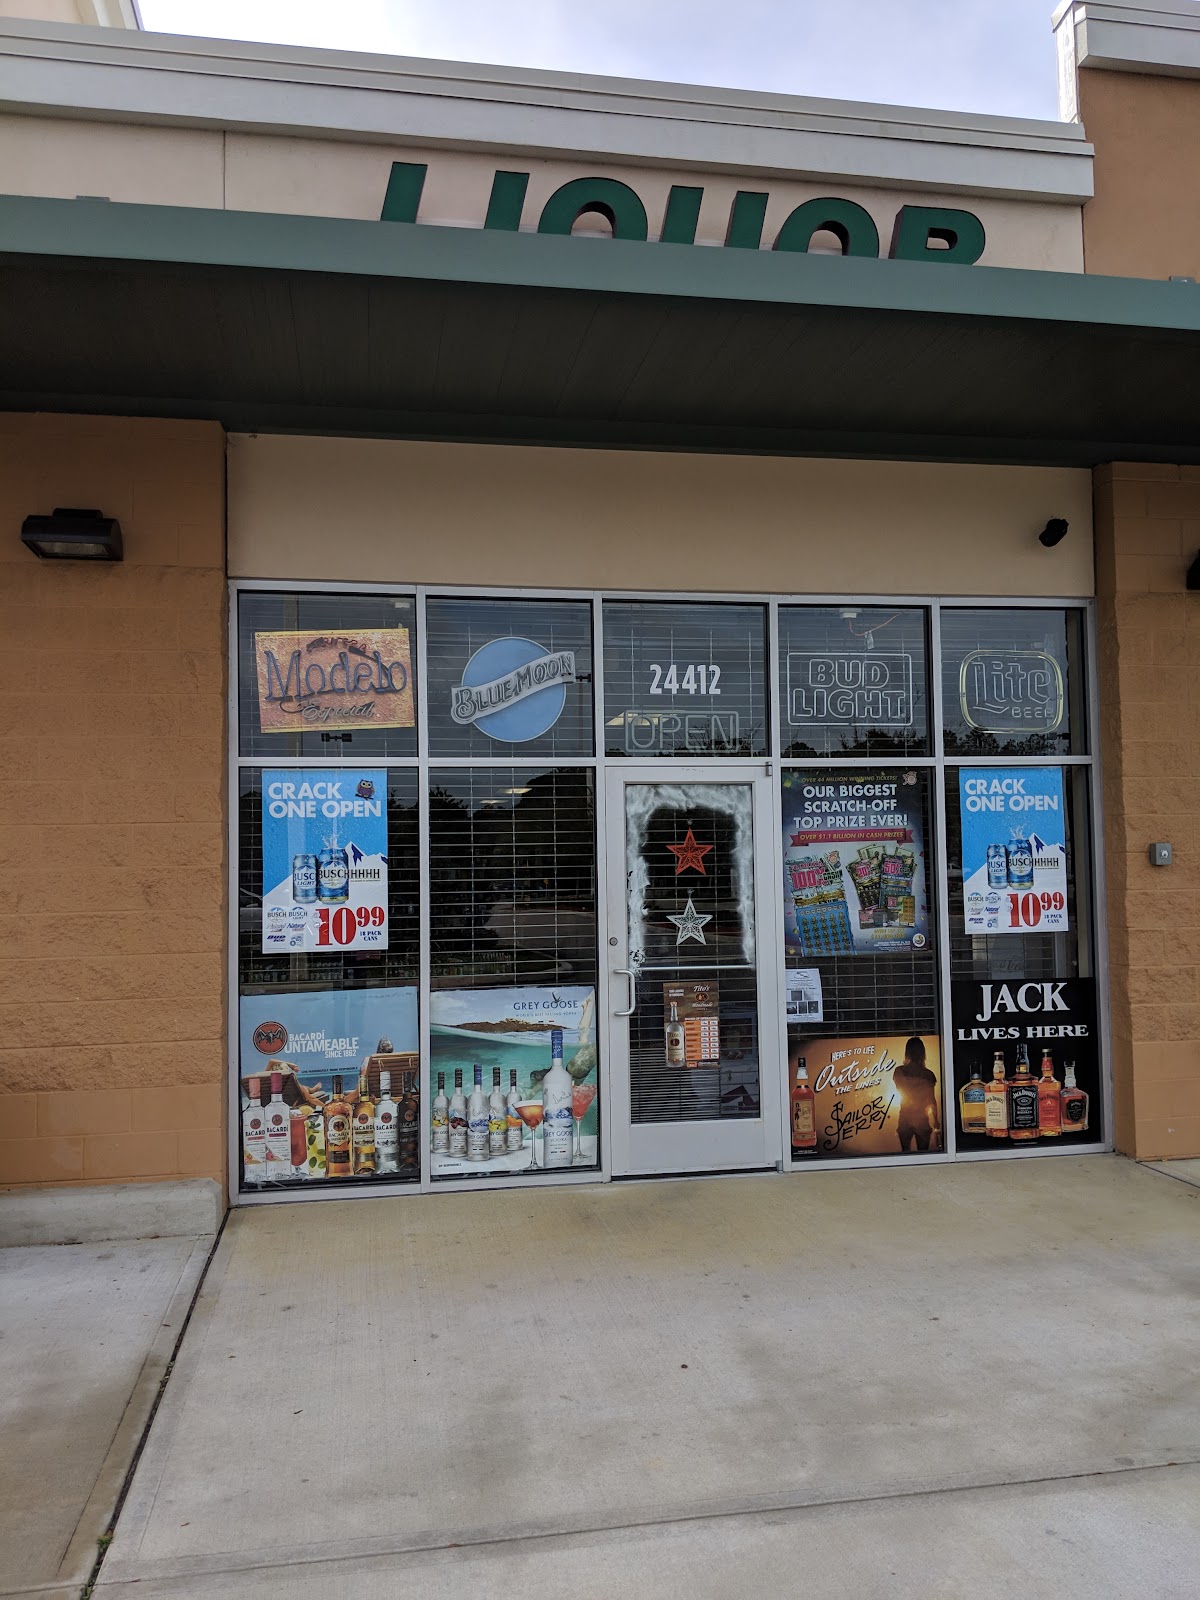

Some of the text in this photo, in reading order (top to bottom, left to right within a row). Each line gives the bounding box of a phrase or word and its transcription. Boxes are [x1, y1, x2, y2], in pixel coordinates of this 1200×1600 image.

[264, 649, 407, 701] Modelo
[650, 664, 721, 695] 24412
[809, 659, 890, 688] BUD
[454, 653, 573, 721] BLUE MOON
[972, 661, 1051, 714] Lite
[301, 700, 375, 721] Especial
[793, 689, 906, 718] LIGHT
[1012, 707, 1053, 718] BEER
[631, 714, 734, 749] OPEN
[268, 783, 343, 799] CRACK
[803, 784, 897, 798] OUR BIGGEST
[965, 779, 1026, 795] CRACK
[268, 801, 382, 818] ONE OPEN
[804, 799, 898, 813] SCRATCH-OFF
[965, 795, 1058, 812] ONE OPEN
[793, 814, 908, 829] TOP PRIZE EVER!
[513, 1000, 579, 1011] GREY GOOSE
[975, 982, 1071, 1022] JACK
[289, 1030, 325, 1041] BACARDÍ
[957, 1025, 1089, 1040] LIVES HERE
[285, 1037, 359, 1054] UNTAMEABLE
[324, 1049, 357, 1058] SINCE 1862
[831, 1048, 852, 1063] HERE'S
[862, 1045, 875, 1055] LIFE
[814, 1049, 897, 1093] Outside
[835, 1078, 882, 1096] THE LINES
[830, 1096, 884, 1126] SAILOR
[823, 1095, 895, 1152] JERRY
